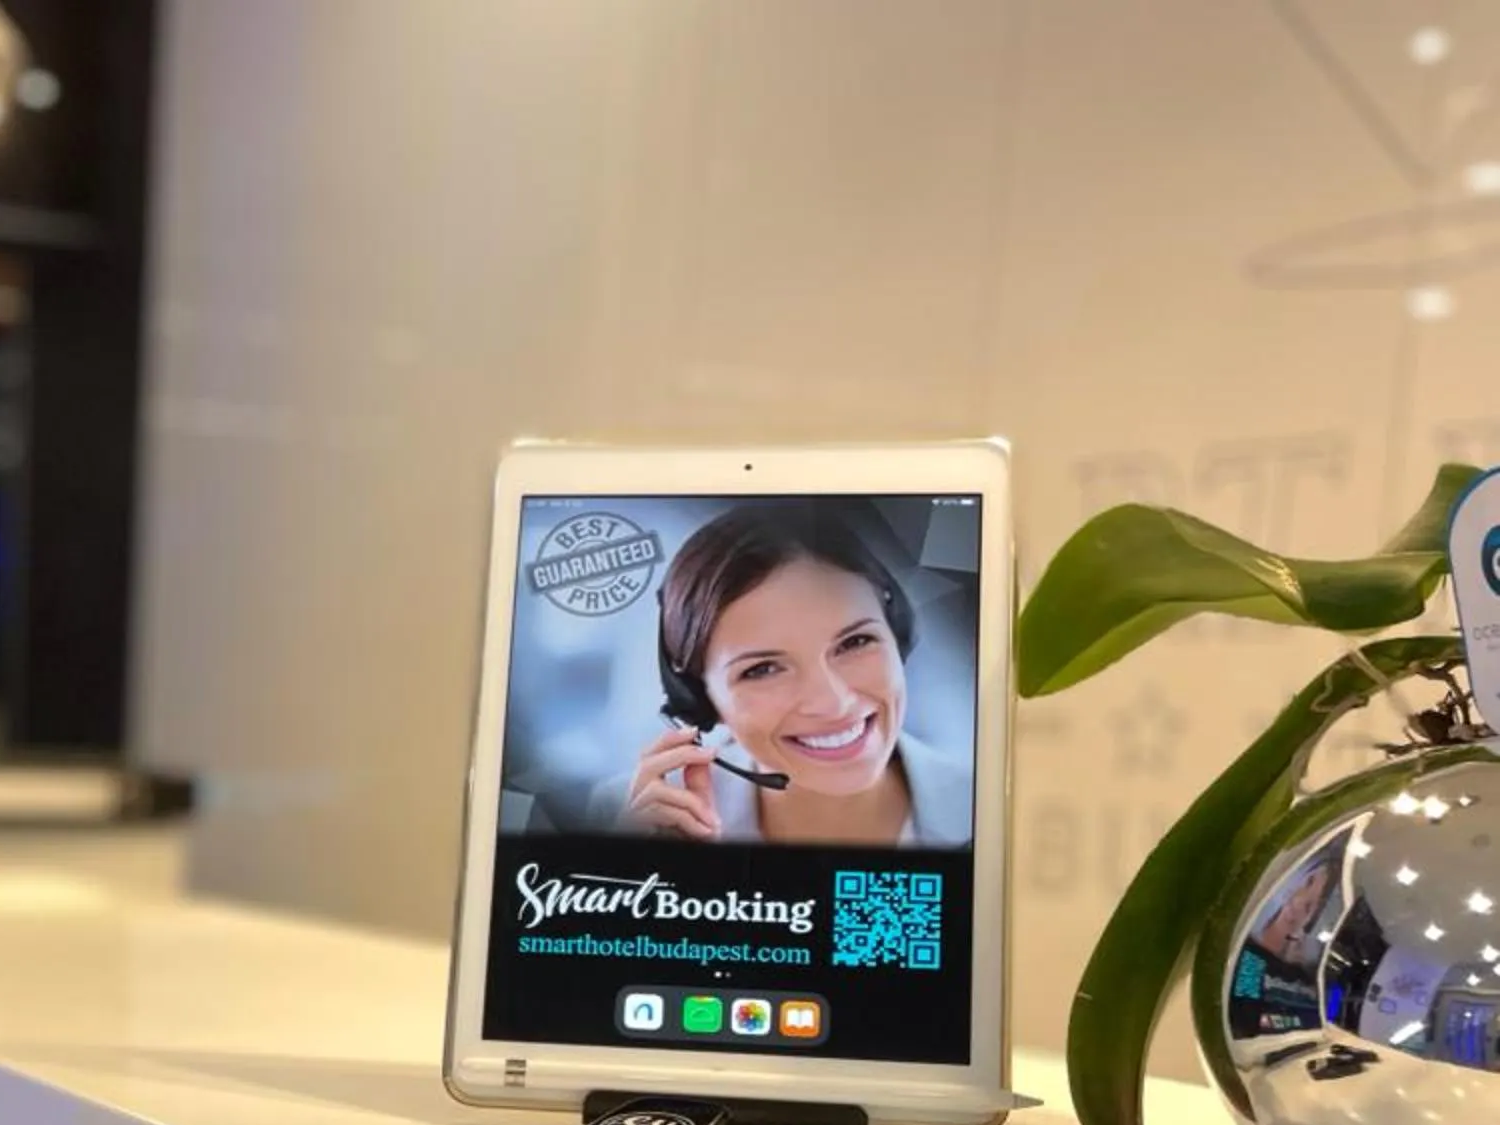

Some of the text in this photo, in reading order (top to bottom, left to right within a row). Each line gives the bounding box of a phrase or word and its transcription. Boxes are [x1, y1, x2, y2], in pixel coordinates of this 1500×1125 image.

[555, 518, 620, 550] BEST
[533, 540, 656, 588] GUARANTEED
[567, 575, 640, 609] PRICE
[516, 863, 816, 933] Smart Booking
[518, 933, 811, 966] smarthotelbudapest.com
